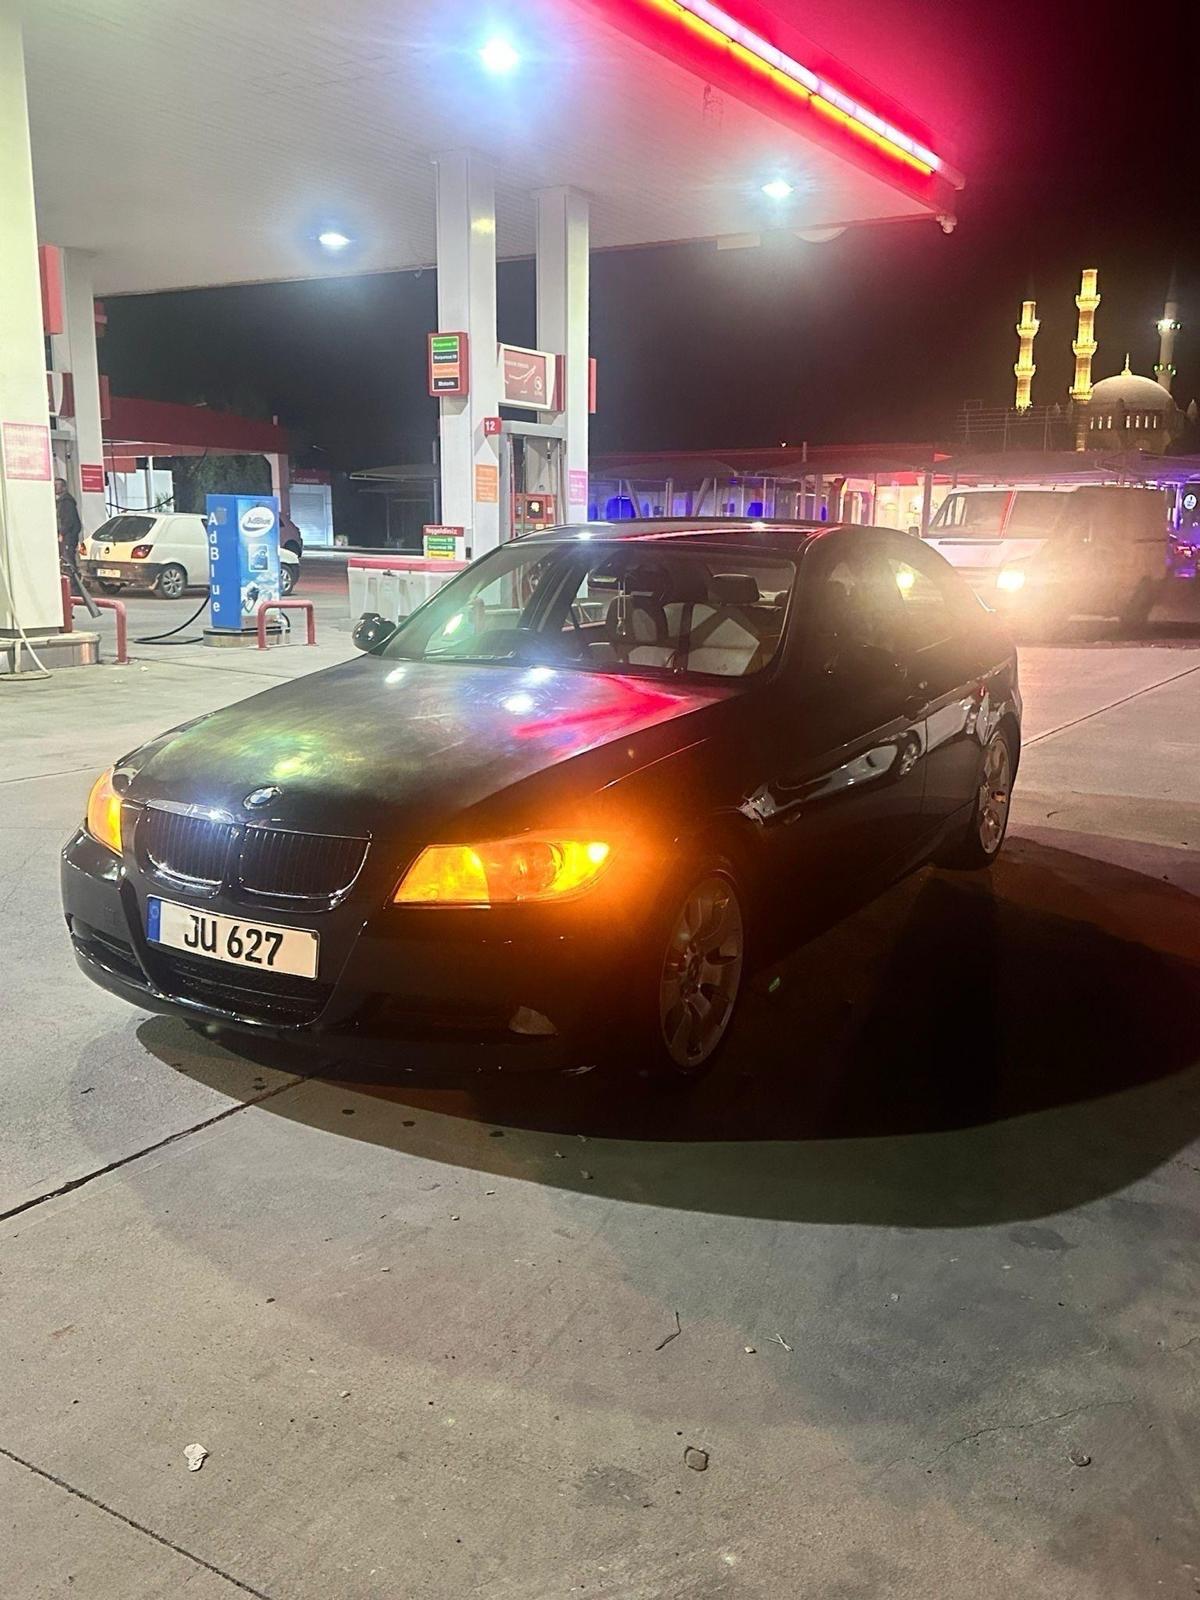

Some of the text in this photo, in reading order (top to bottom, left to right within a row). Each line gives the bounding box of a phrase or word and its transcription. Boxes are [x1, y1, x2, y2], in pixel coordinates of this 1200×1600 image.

[485, 420, 496, 431] 12
[208, 512, 221, 612] AdBlue
[184, 914, 284, 966] JU 627
